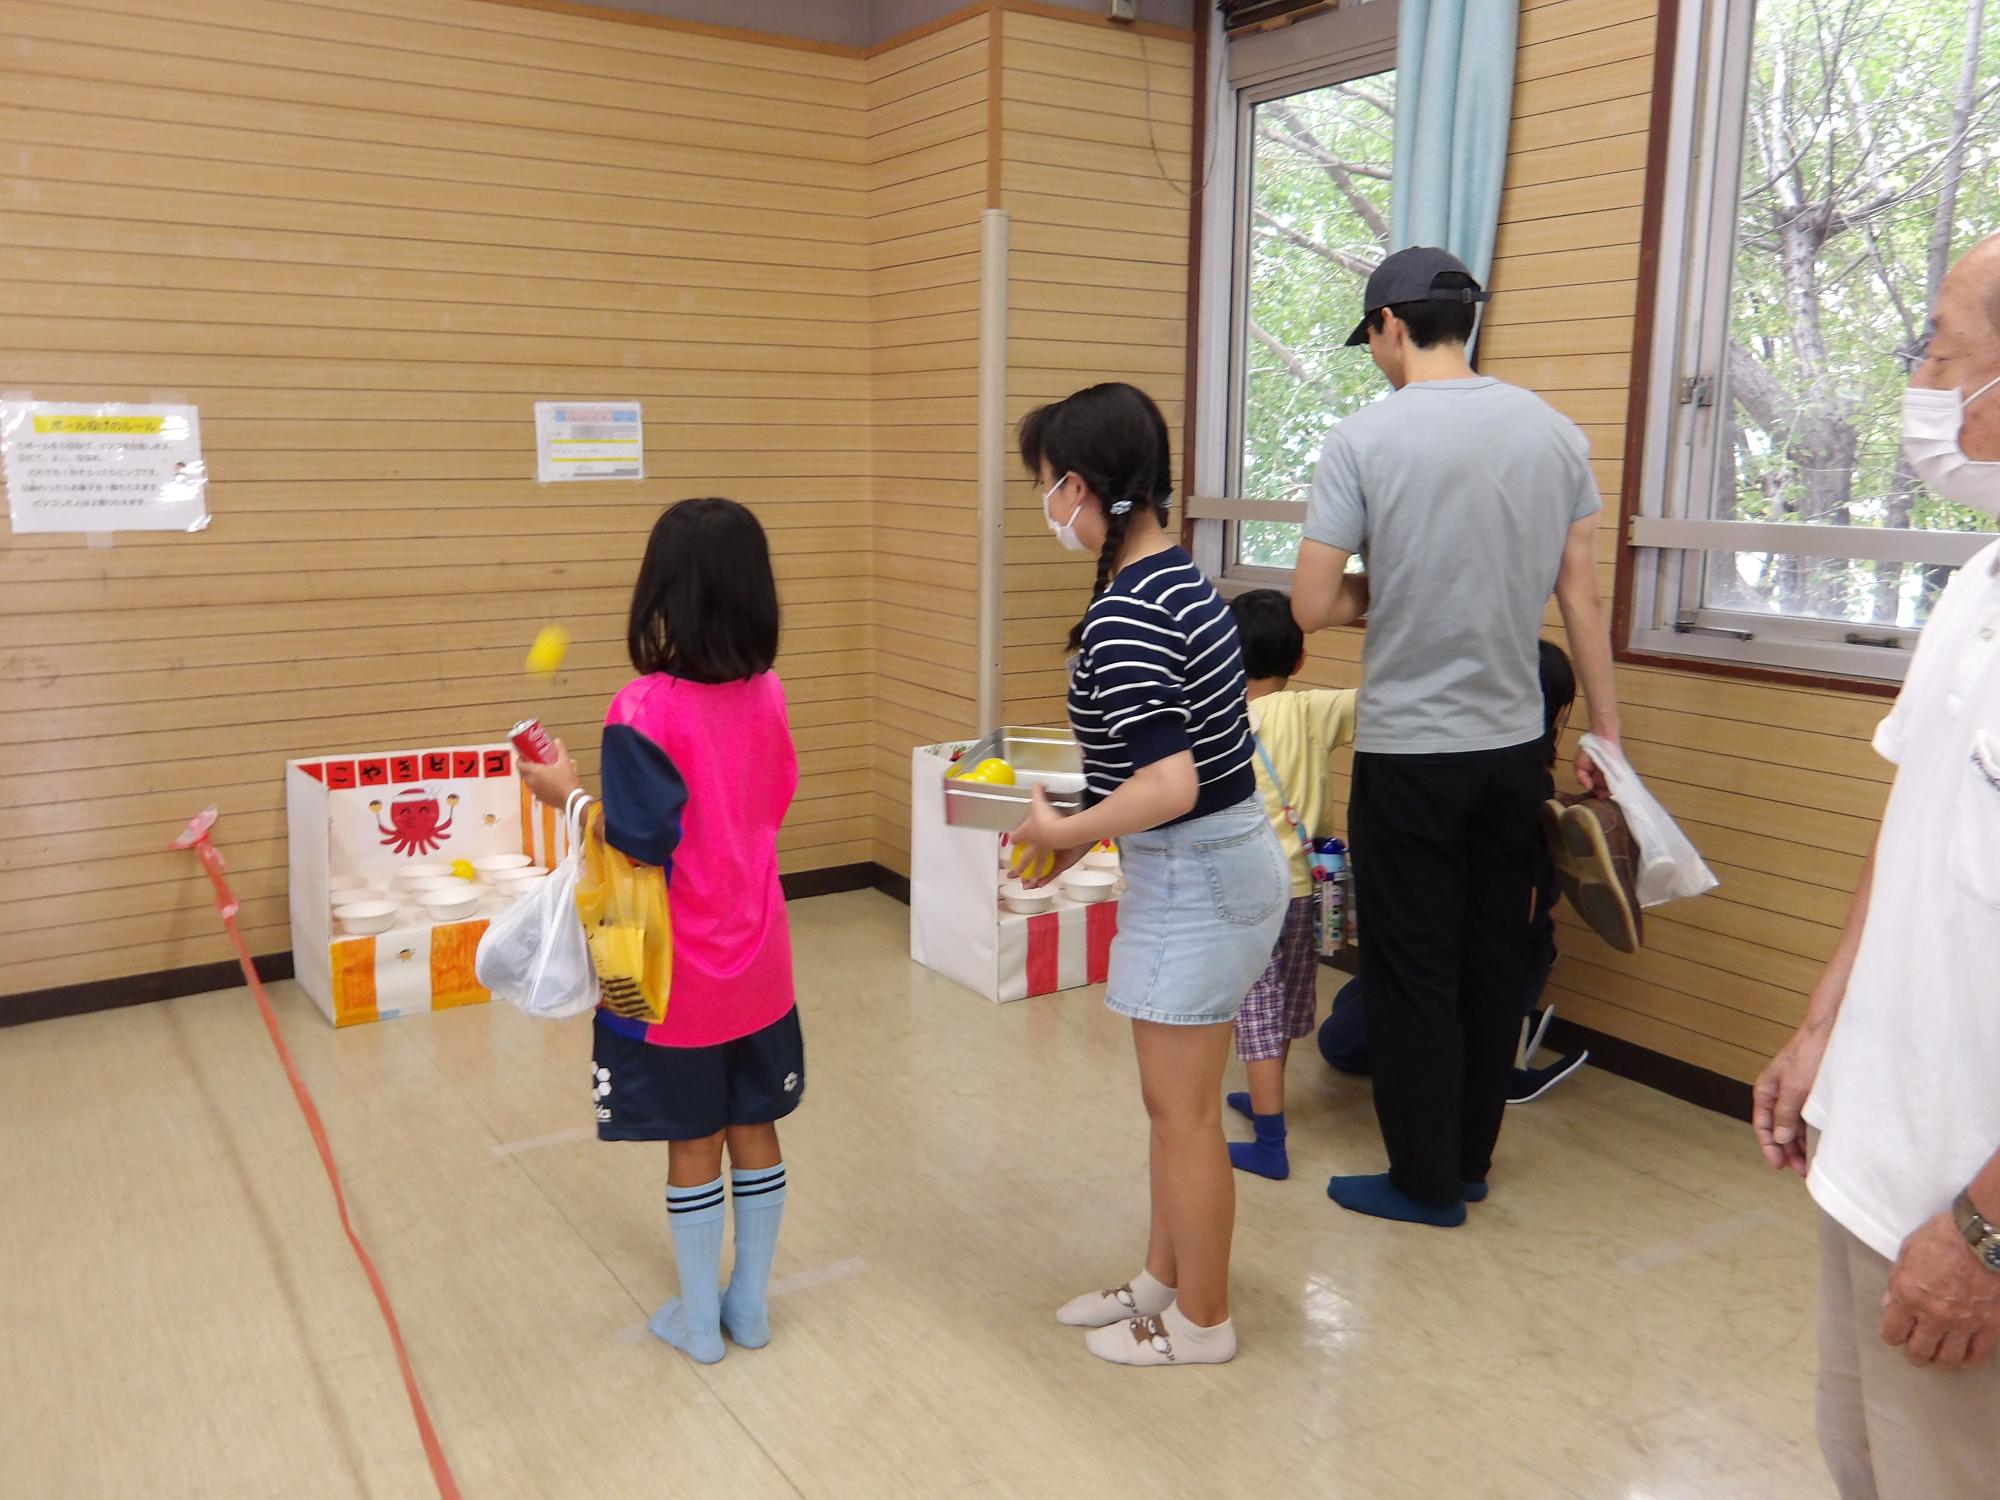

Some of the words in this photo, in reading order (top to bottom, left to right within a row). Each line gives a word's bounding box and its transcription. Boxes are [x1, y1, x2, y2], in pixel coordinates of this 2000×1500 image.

[333, 751, 510, 783] こやきビンゴ
